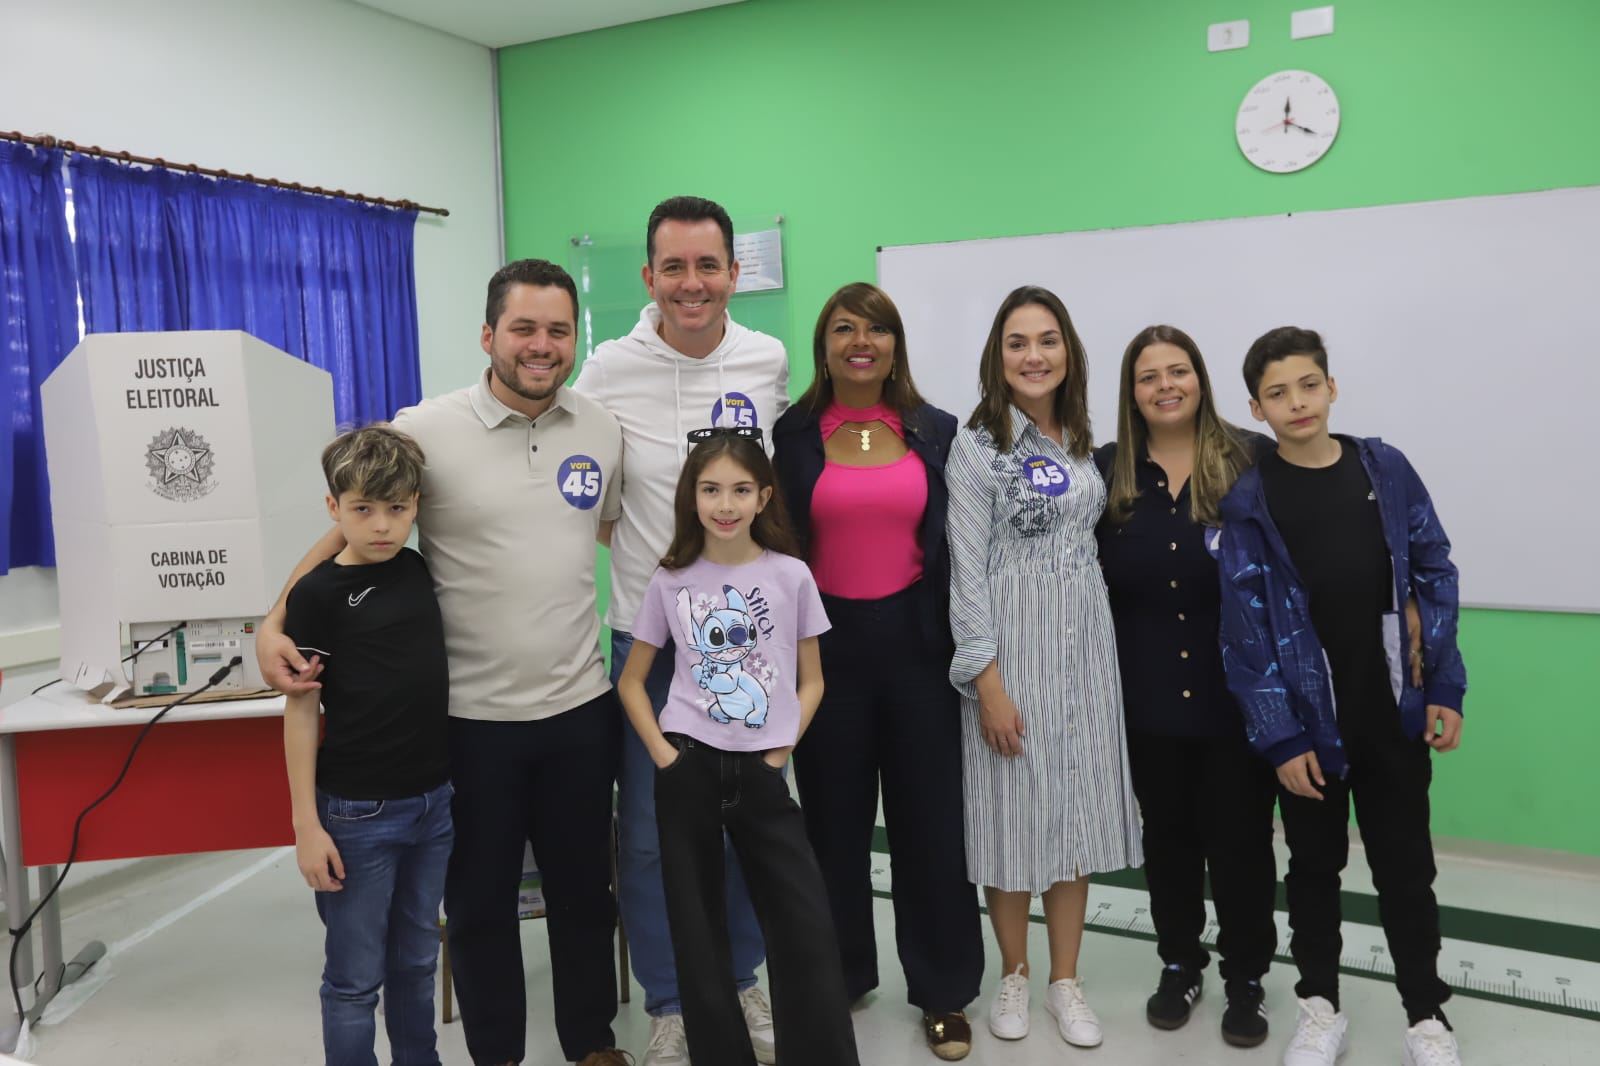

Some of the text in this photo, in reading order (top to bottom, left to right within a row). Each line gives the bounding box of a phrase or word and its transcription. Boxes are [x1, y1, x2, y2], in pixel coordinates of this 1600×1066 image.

[135, 357, 206, 383] JUSTIÇA
[126, 388, 220, 409] ELEITORAL
[725, 398, 745, 407] VOTE
[570, 462, 592, 470] VOTE
[1028, 460, 1047, 468] VOTE
[562, 471, 600, 497] 45
[1032, 465, 1065, 487] 45
[151, 549, 228, 567] CABINA DE
[158, 569, 225, 590] VOTAÇÃO
[745, 586, 775, 641] Stitch
